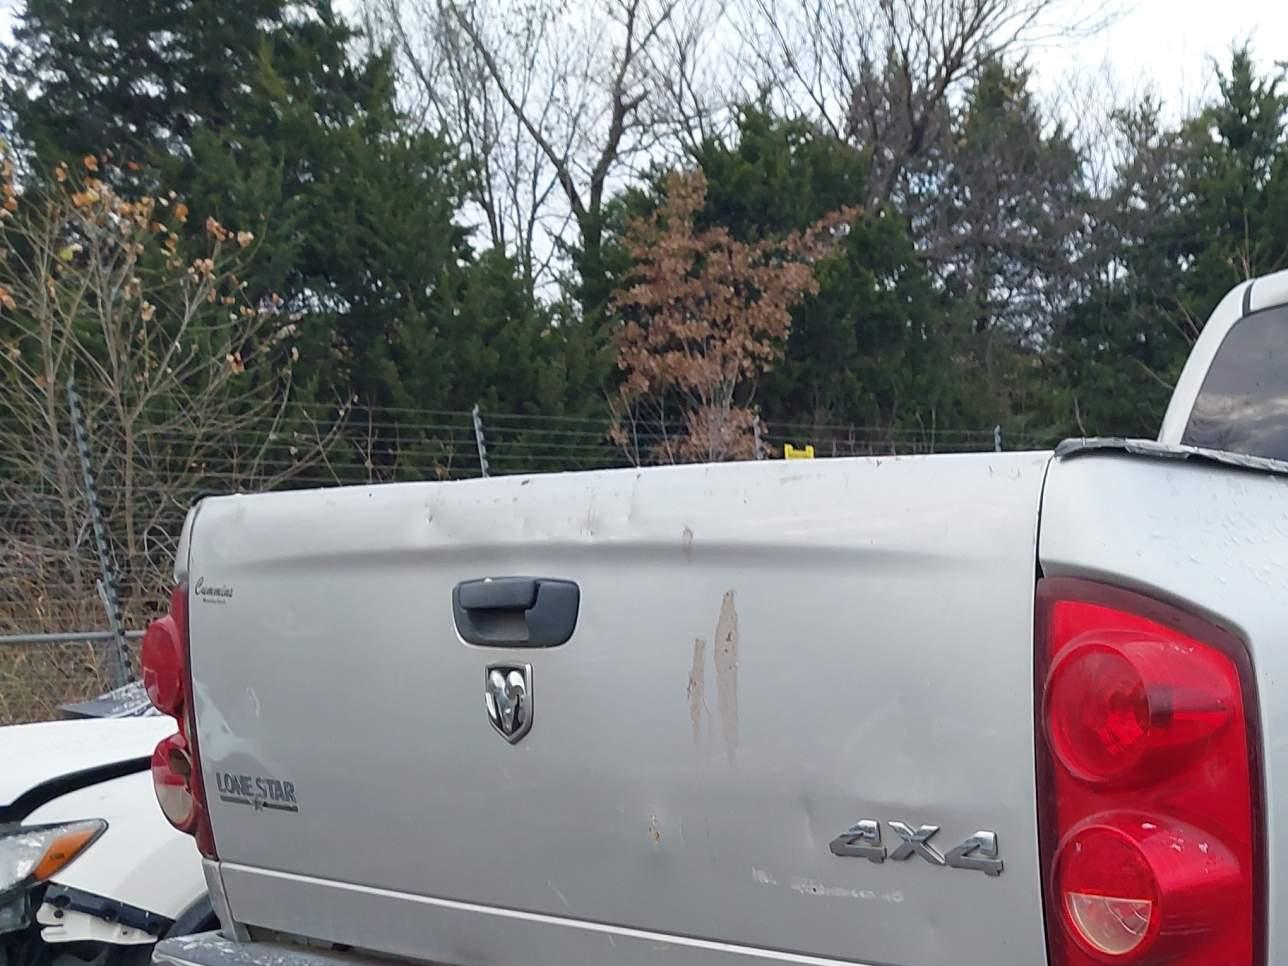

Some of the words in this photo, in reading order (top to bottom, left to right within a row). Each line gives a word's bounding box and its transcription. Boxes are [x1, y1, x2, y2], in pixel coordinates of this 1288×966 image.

[195, 576, 233, 598] Cummins
[216, 772, 255, 797] LONE
[255, 777, 297, 803] STAR
